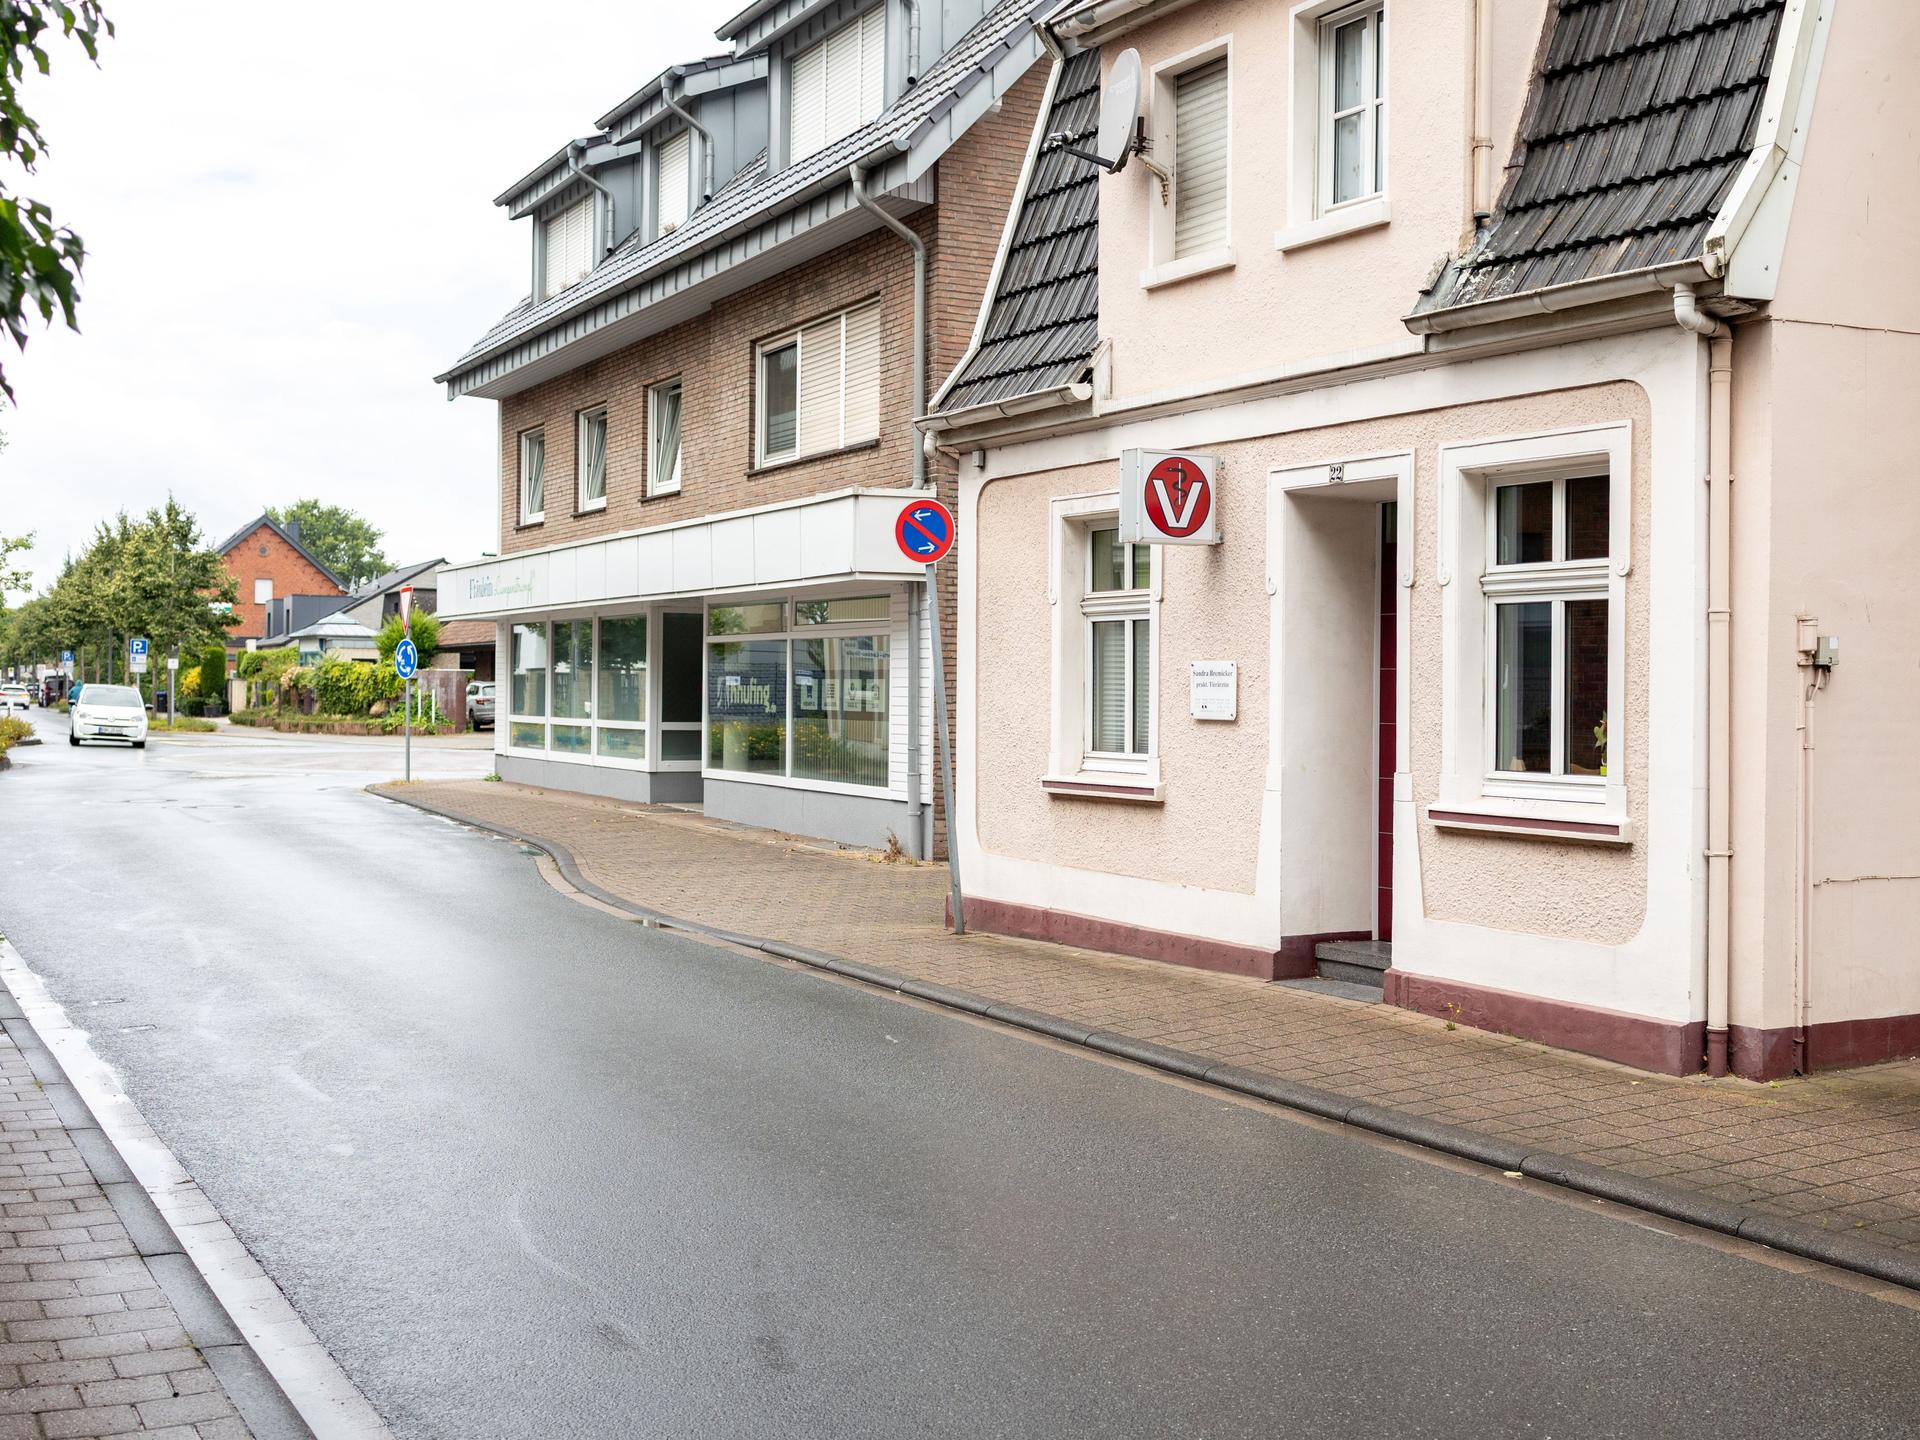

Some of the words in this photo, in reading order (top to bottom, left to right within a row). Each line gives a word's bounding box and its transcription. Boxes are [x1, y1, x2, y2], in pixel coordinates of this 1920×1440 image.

[1330, 466, 1342, 481] 22
[1152, 478, 1204, 529] V
[133, 641, 143, 653] P
